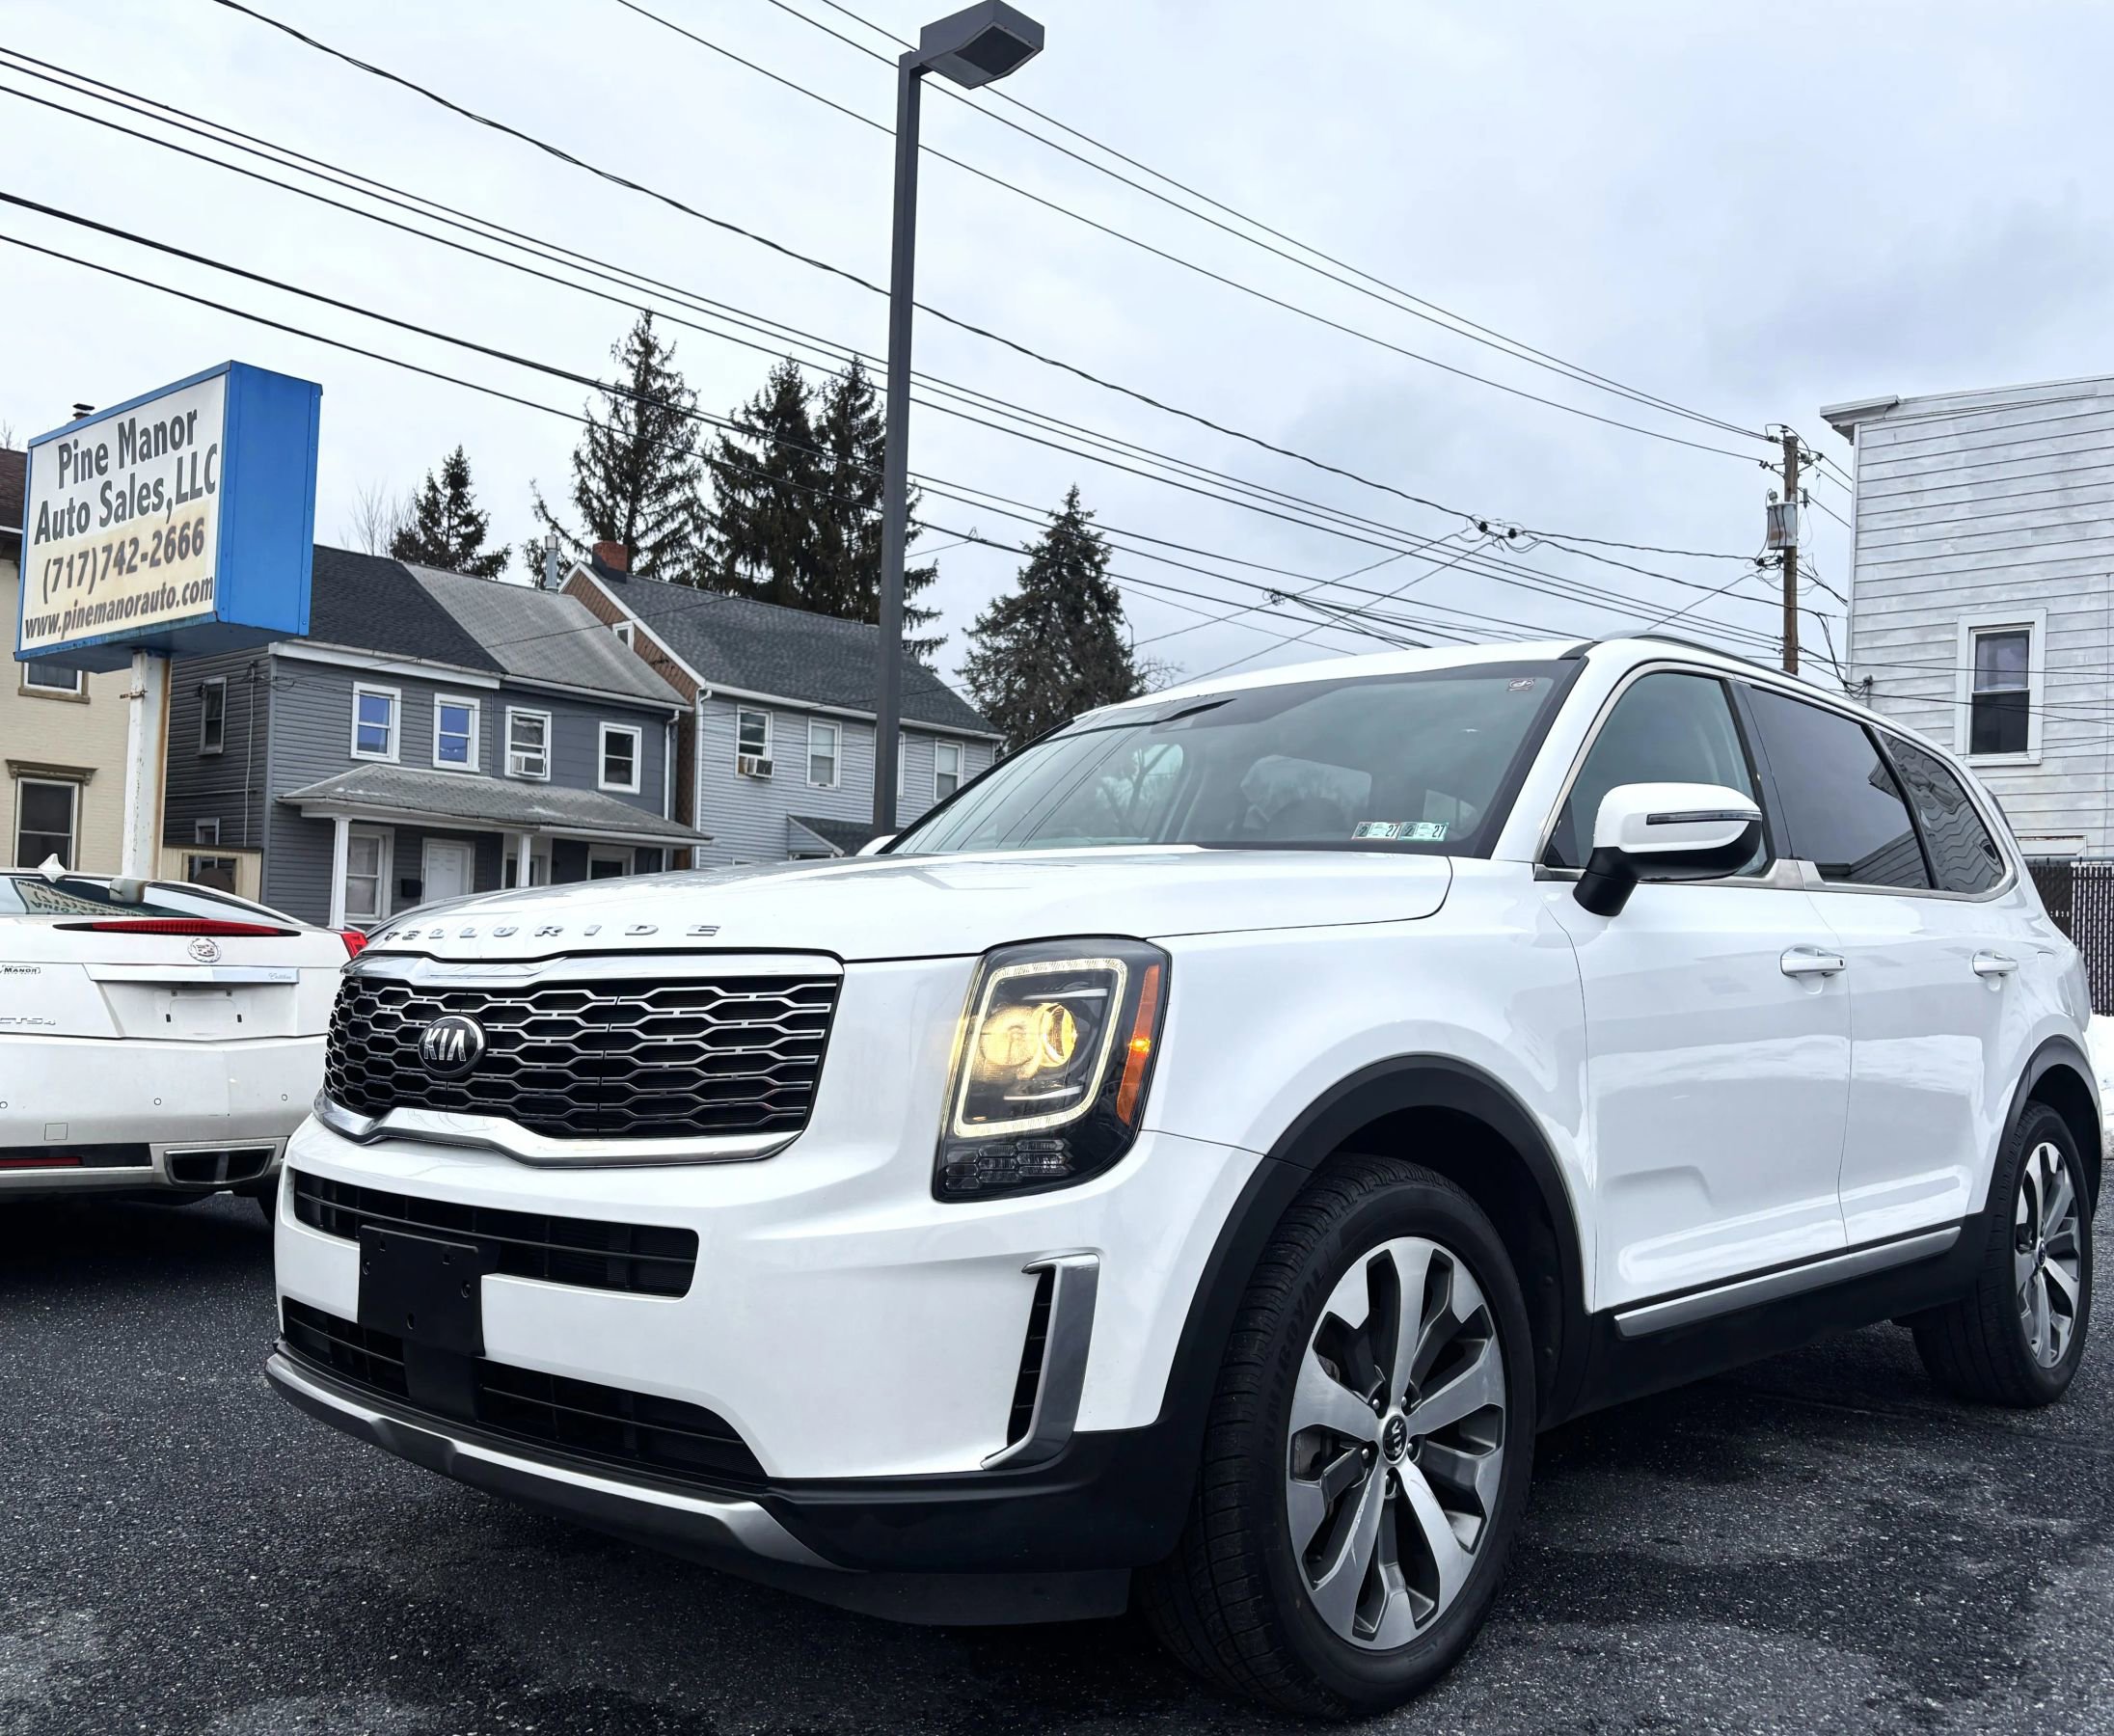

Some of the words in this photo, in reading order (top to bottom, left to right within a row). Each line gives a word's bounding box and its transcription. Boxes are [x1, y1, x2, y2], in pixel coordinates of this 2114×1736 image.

[58, 438, 109, 489] Pine
[117, 409, 198, 469] Manor
[34, 497, 91, 546] Auto
[42, 517, 205, 605] (717)742-2666
[25, 576, 214, 640] www.pinemanorauto.com
[1385, 825, 1398, 837] 27
[1432, 825, 1445, 838] 27
[384, 923, 721, 942] TELLURIDE
[423, 1027, 467, 1062] KIA
